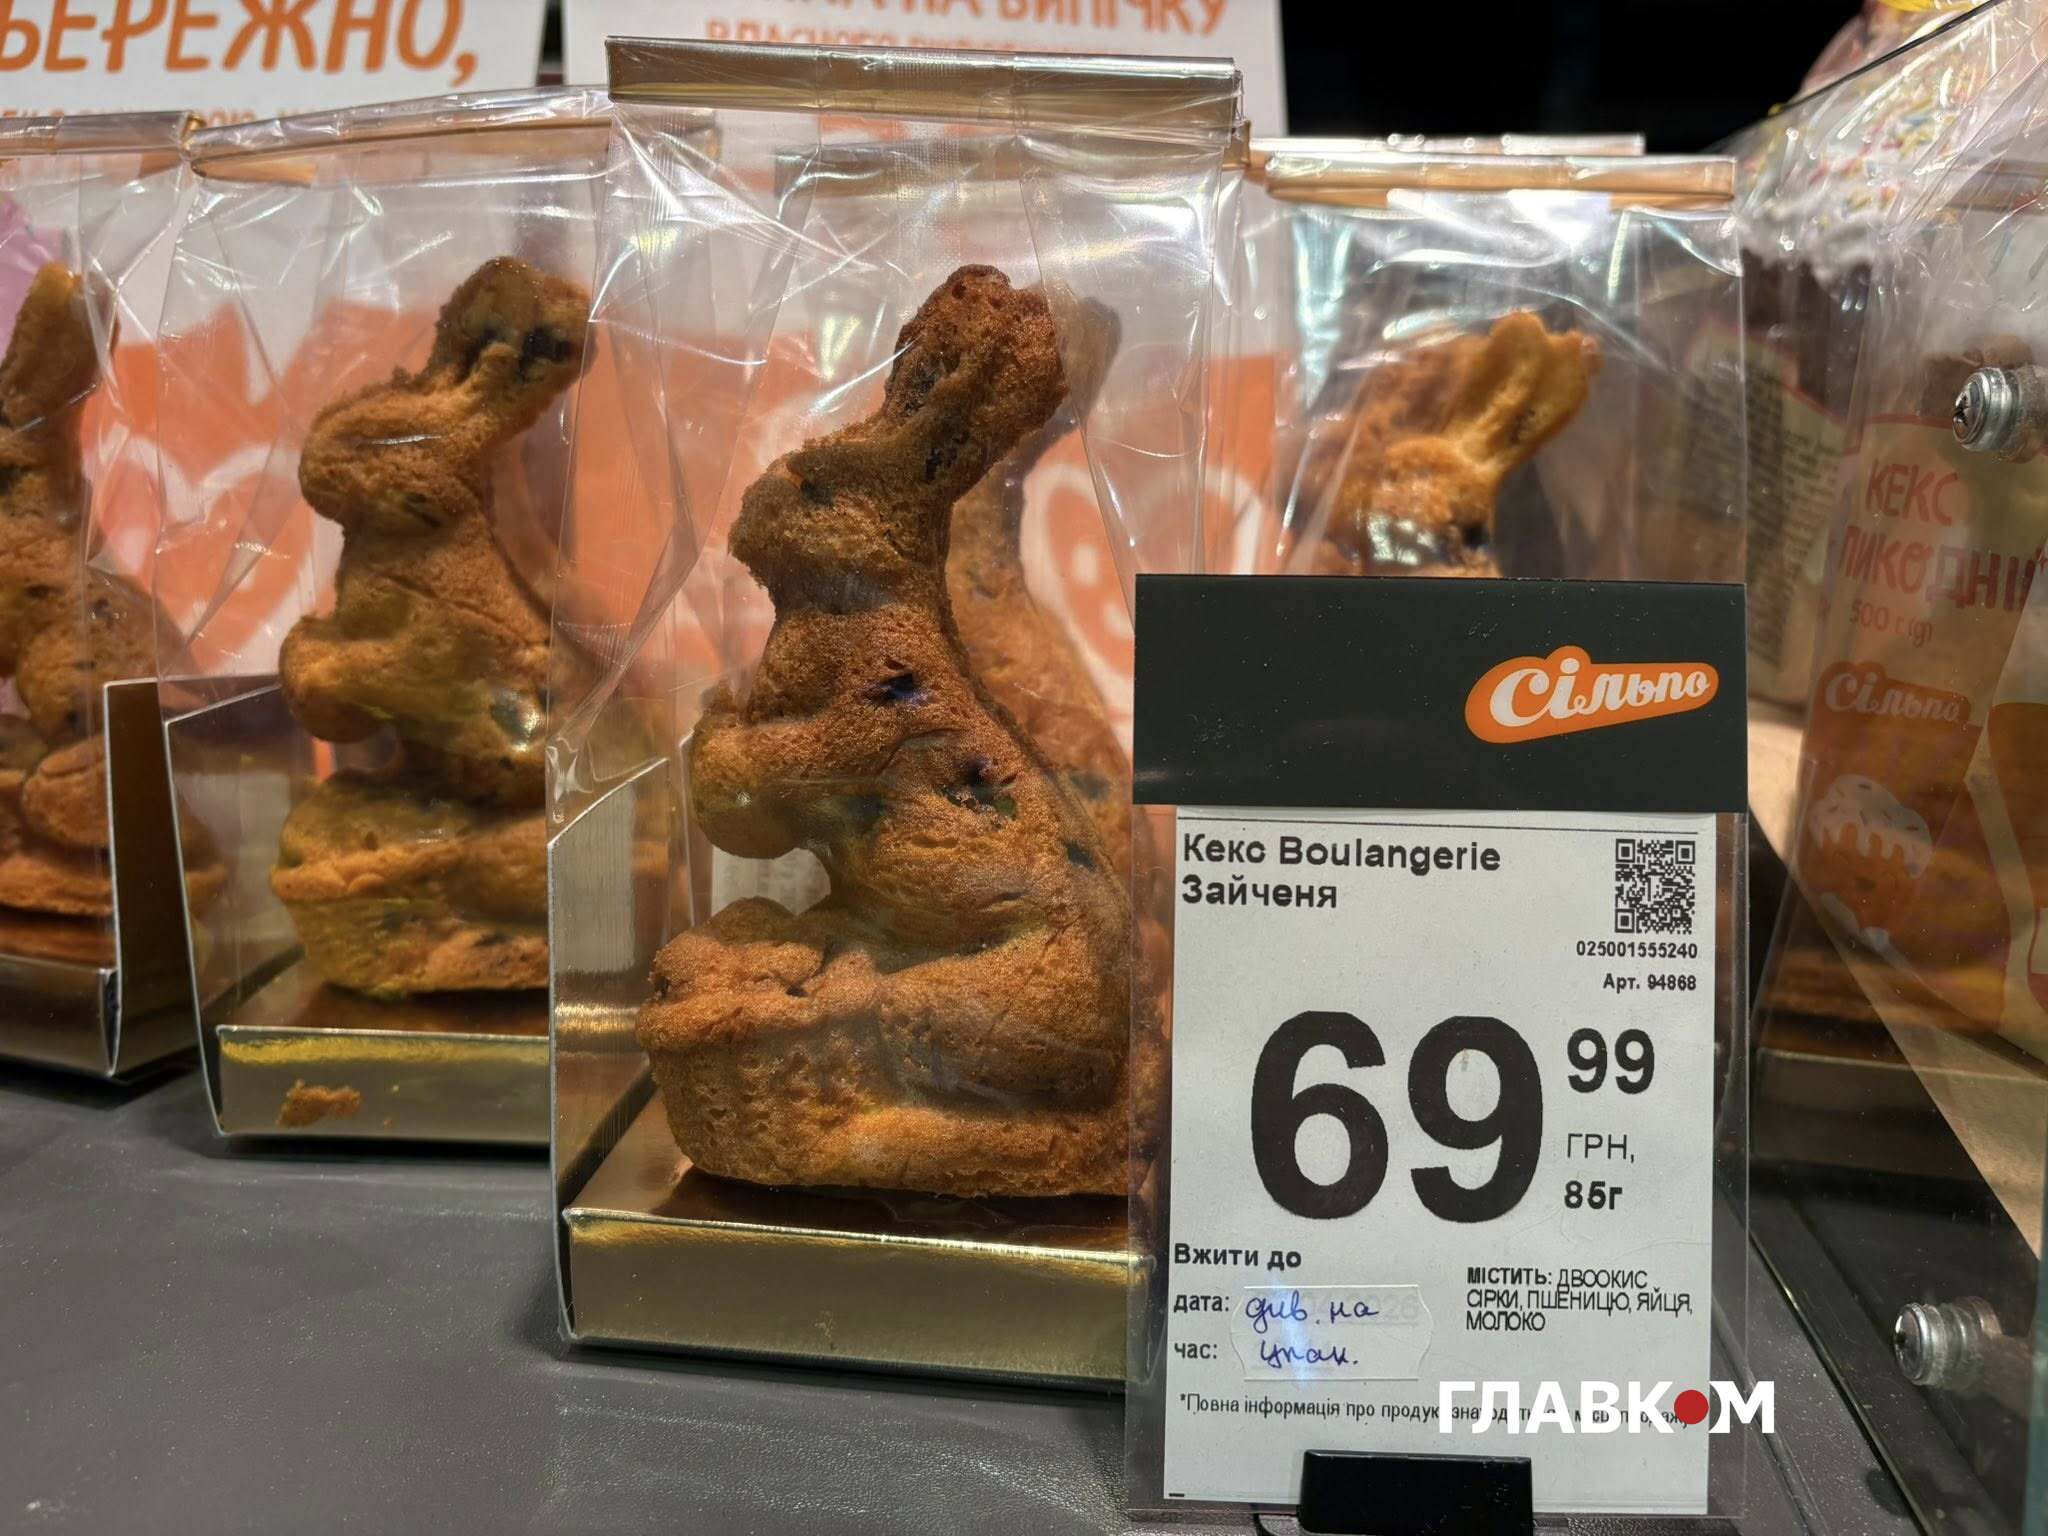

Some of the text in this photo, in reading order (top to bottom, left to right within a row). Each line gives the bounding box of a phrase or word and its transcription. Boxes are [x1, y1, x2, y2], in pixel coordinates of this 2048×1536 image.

[1865, 459, 1959, 527] КЕКС
[1490, 658, 1711, 727] Сільпо
[1825, 672, 1961, 723] Сільпо
[1184, 833, 1501, 876] Кекс Boulangerie
[1182, 874, 1337, 908] Зайченя
[1576, 940, 1698, 959] 025001555240
[1603, 973, 1697, 993] Арт. 94868
[1567, 1028, 1655, 1094] 99
[1251, 1011, 1543, 1223] 69
[1567, 1133, 1635, 1163] ГРН,
[1564, 1180, 1623, 1210] 85г
[1174, 1243, 1302, 1272] Вжити до
[1467, 1267, 1648, 1290] МІСТИТЬ: ДВООКИС
[1173, 1293, 1230, 1313] дата:
[1330, 1301, 1379, 1324] на
[1467, 1287, 1693, 1317] СІРКИ, ПШЕНИЦЮ, ЯЙЦЯ,
[1466, 1311, 1546, 1331] МОЛОКО
[1174, 1343, 1218, 1360] час:
[1244, 1395, 1340, 1419] інформація
[1346, 1402, 1375, 1421] про
[1381, 1404, 1440, 1423] продук
